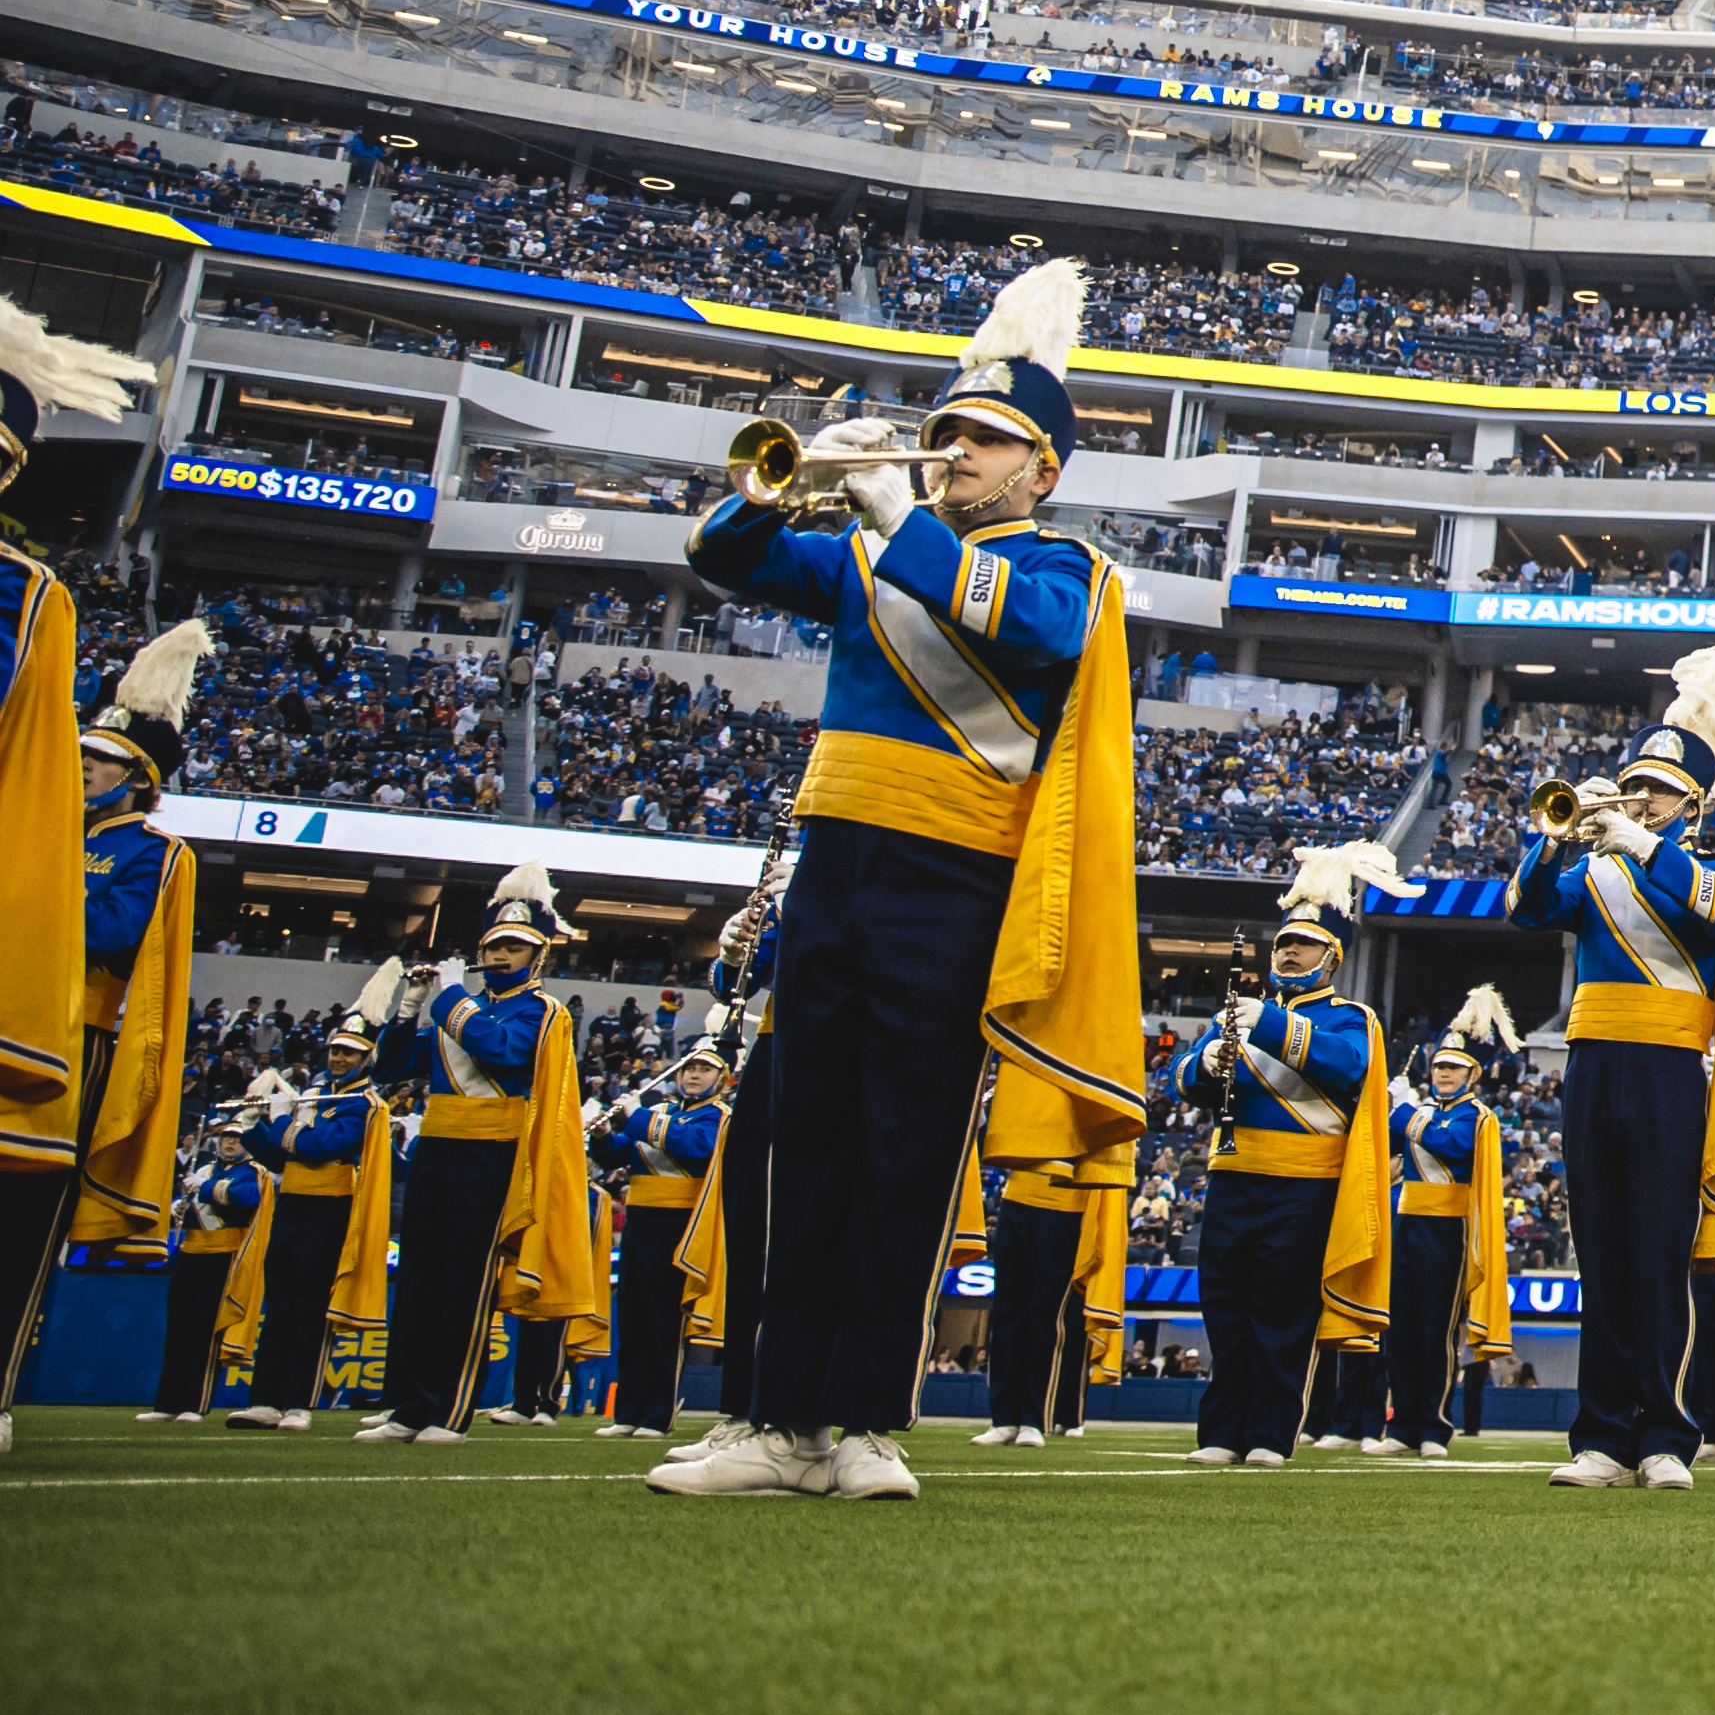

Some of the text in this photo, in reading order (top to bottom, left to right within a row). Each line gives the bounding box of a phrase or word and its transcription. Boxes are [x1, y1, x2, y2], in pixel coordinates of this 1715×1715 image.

[769, 25, 919, 67] HOUSE
[1160, 79, 1443, 128] RAMS HOUSE
[1620, 391, 1708, 415] LOS
[170, 462, 416, 512] 50/50 $135,720
[514, 525, 604, 554] Corona
[254, 811, 279, 837] 8
[1290, 1020, 1304, 1057] BRUINS
